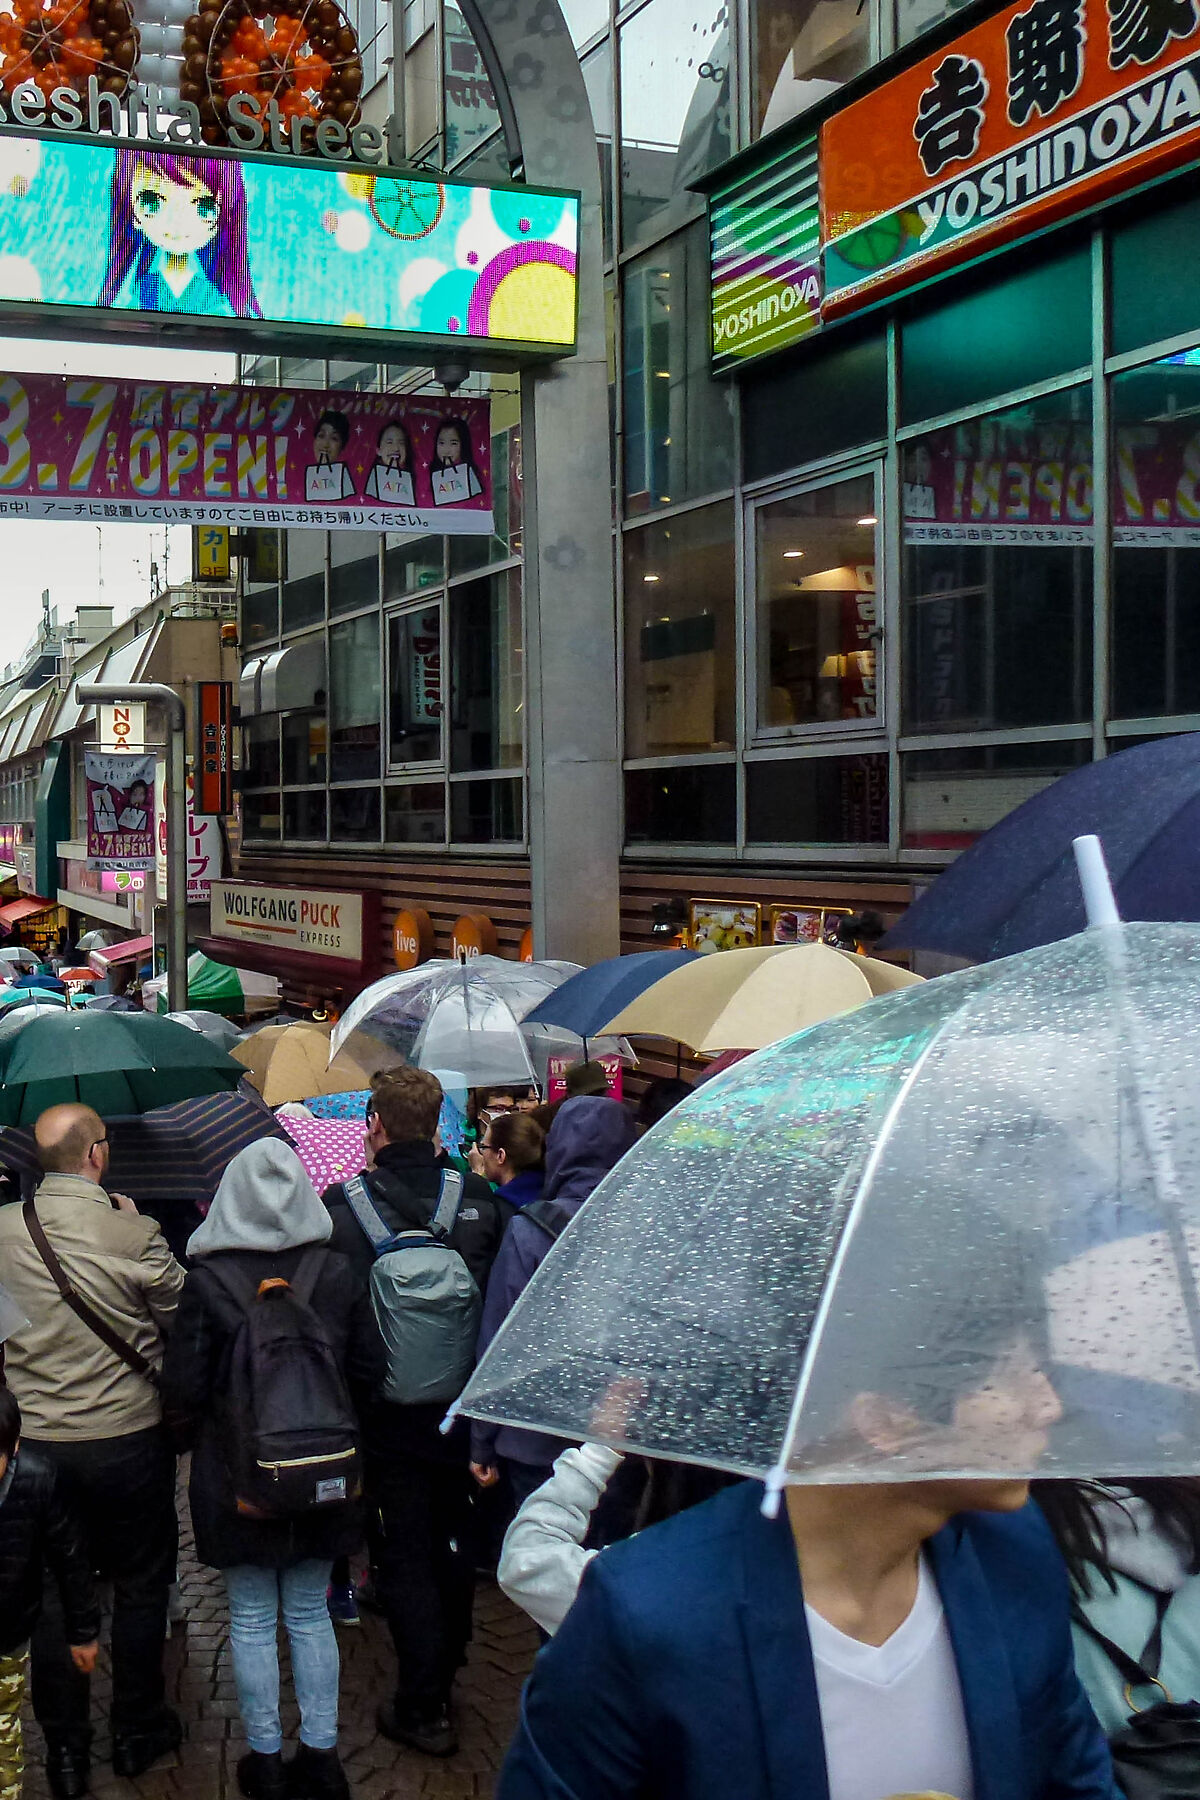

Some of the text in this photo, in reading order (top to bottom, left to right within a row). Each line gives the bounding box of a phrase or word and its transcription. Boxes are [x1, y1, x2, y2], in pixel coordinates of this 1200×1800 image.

[227, 92, 406, 167] Street
[918, 70, 1200, 246] YOSHINOYA
[713, 276, 819, 345] YOSHINOYA
[130, 385, 296, 432] 原宿アルタ
[129, 429, 289, 500] OPEN!
[201, 566, 225, 577] 3F
[224, 891, 341, 929] WOLFGANG PUCK
[301, 931, 341, 948] EXPRESS
[396, 930, 416, 954] live
